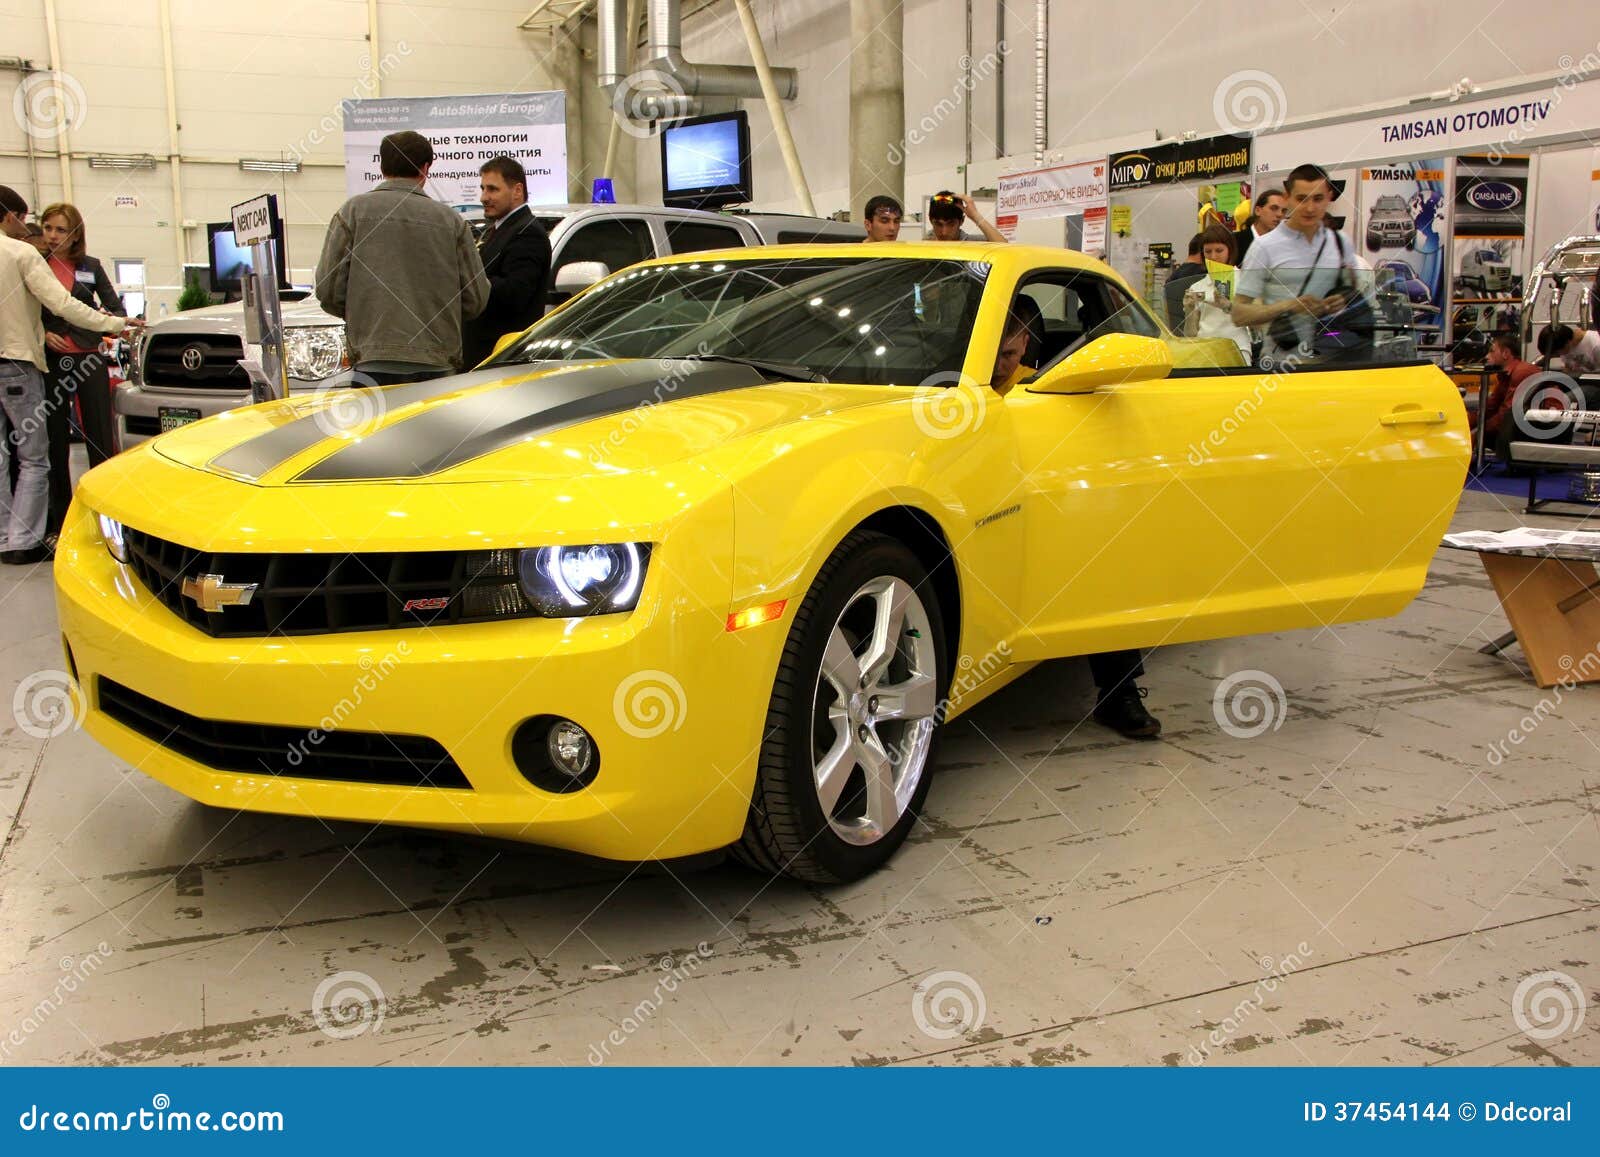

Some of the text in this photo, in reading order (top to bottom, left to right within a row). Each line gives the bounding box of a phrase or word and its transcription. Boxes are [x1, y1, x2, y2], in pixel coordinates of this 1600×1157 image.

[429, 102, 545, 117] AutoShield Europe
[1381, 100, 1551, 143] TAMSAN OTOMOTIV
[454, 132, 528, 145] технологии
[478, 148, 541, 162] покрытия
[1177, 157, 1195, 177] для
[1197, 147, 1248, 173] водителей
[1371, 168, 1415, 180] TAMSAN
[1067, 186, 1076, 198] НЕ
[1077, 183, 1104, 198] ВИДНО
[253, 208, 267, 228] CAR
[403, 597, 450, 612] RS
